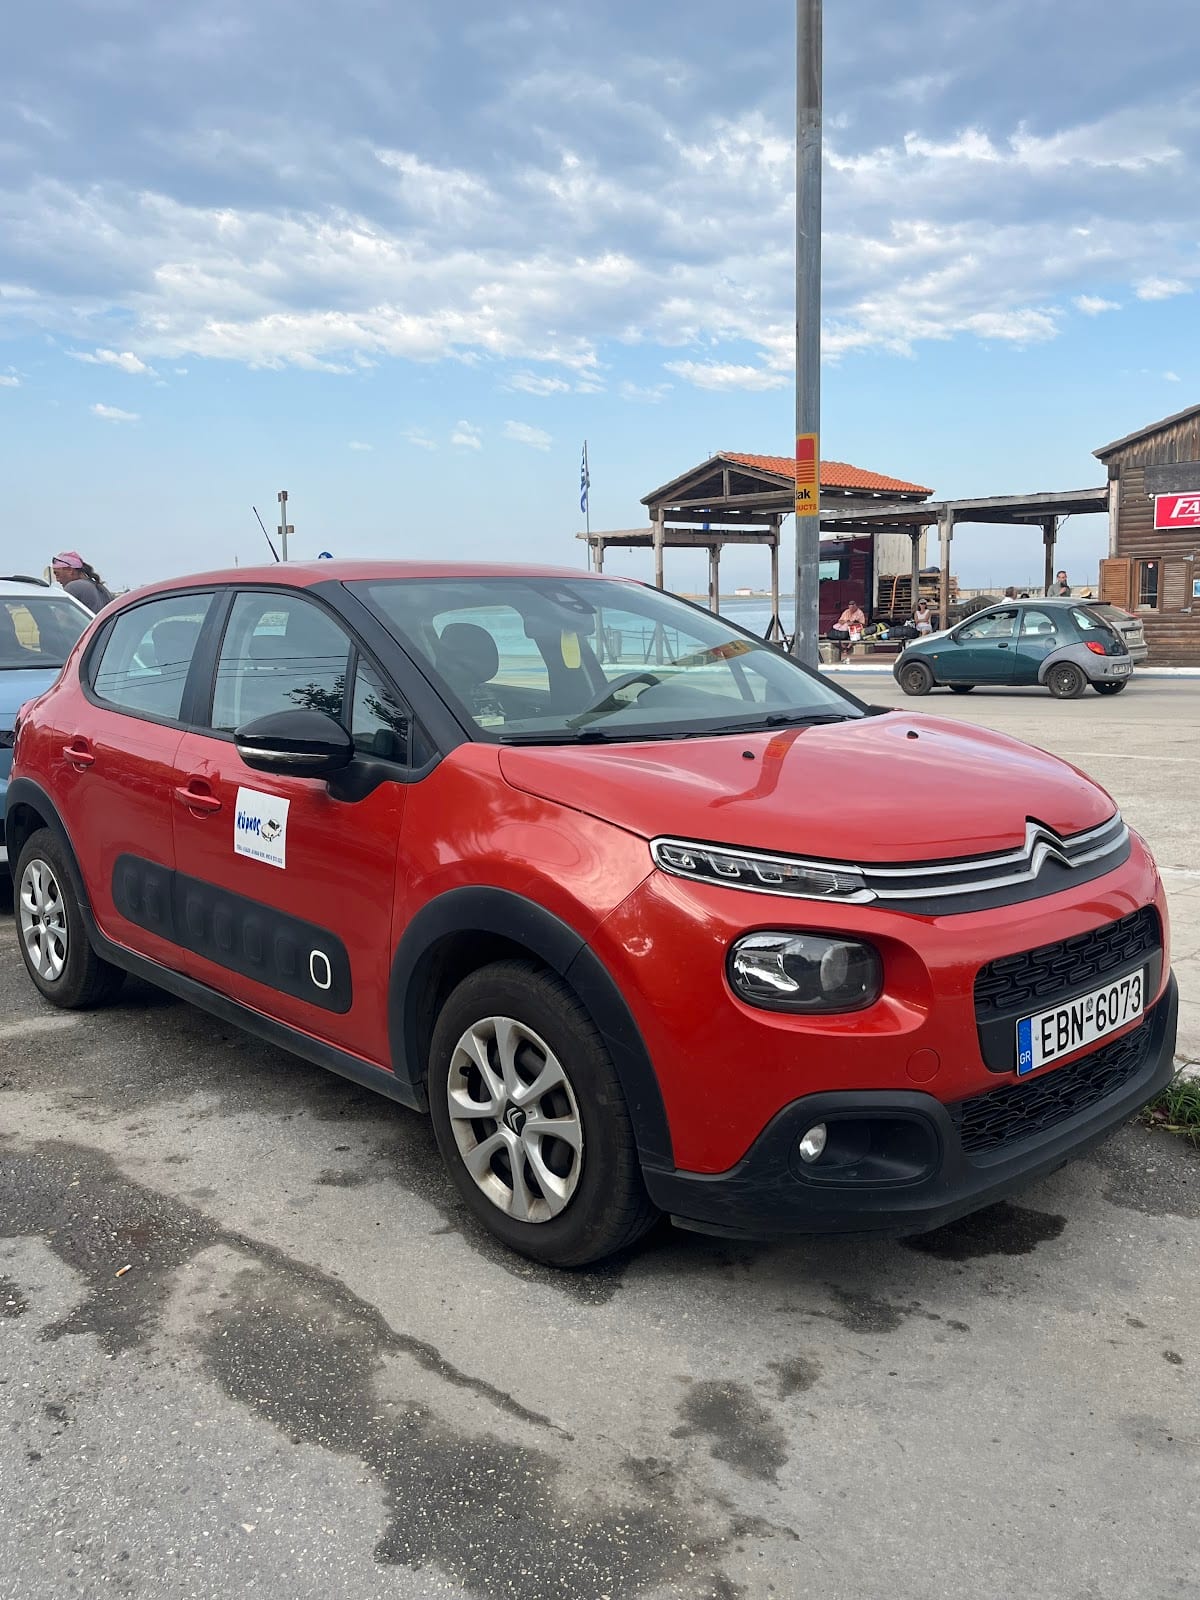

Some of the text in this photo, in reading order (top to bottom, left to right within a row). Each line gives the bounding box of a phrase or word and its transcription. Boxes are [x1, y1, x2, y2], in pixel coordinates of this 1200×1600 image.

[796, 488, 811, 500] ak
[1041, 976, 1141, 1059] EBN-6073
[1019, 1050, 1031, 1065] GR
